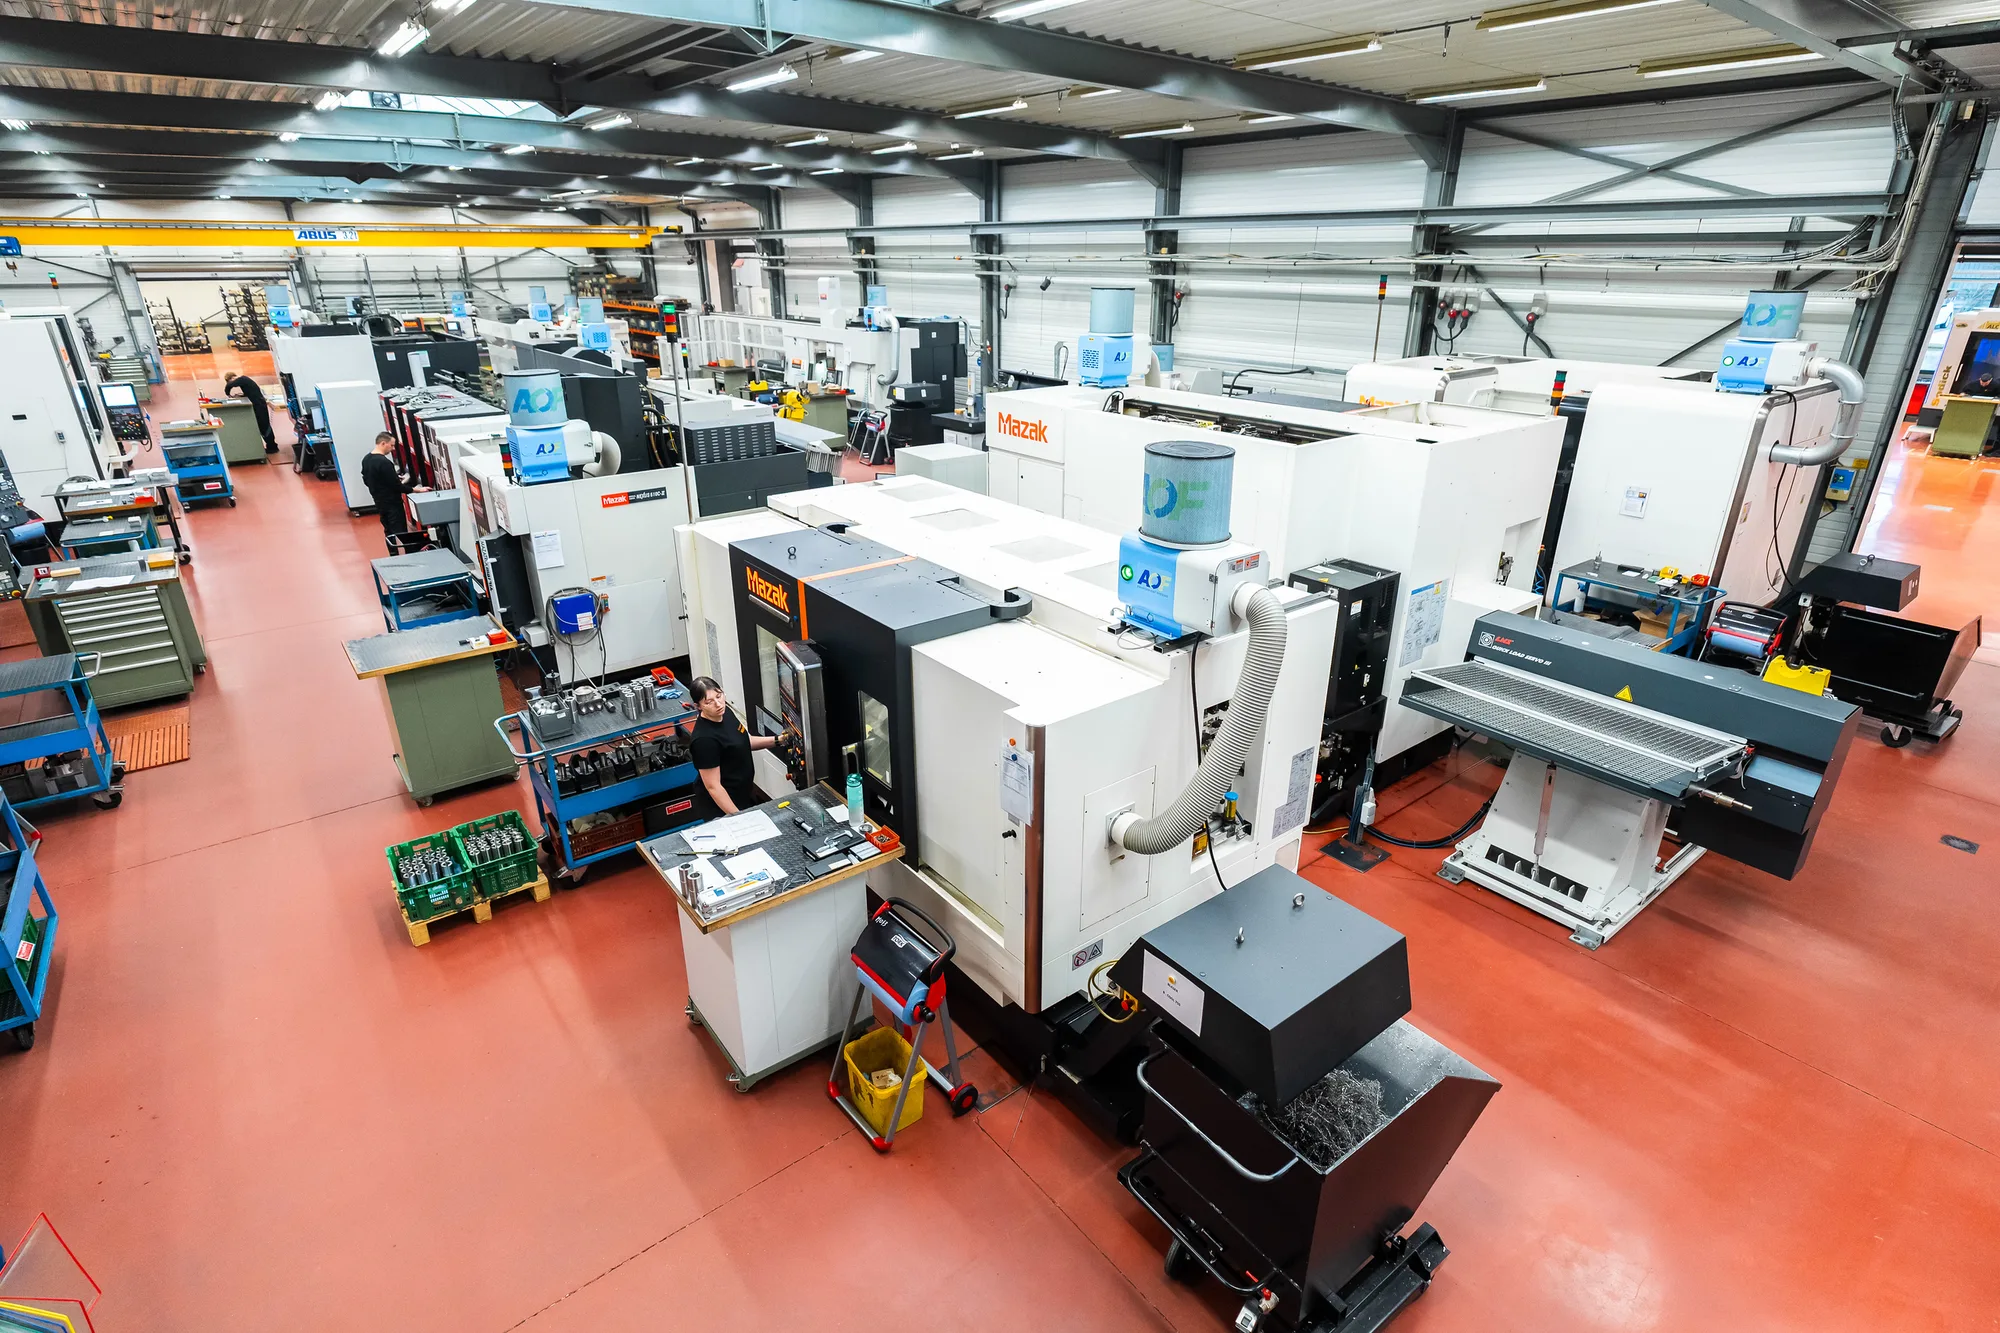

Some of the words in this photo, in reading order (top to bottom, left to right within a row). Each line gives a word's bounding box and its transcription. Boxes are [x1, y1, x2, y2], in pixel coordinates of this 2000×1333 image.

[297, 230, 337, 240] ABUS
[1743, 303, 1798, 327] AOF
[1737, 356, 1767, 367] AOF
[512, 386, 565, 414] AOF
[998, 411, 1048, 444] Mazak
[535, 442, 561, 456] AOF
[603, 495, 627, 505] Mazak
[745, 565, 790, 613] Mazak
[1137, 569, 1172, 592] AOF
[1492, 645, 1509, 653] QUICK
[1509, 650, 1525, 658] LOAD
[1525, 655, 1544, 664] SERVO
